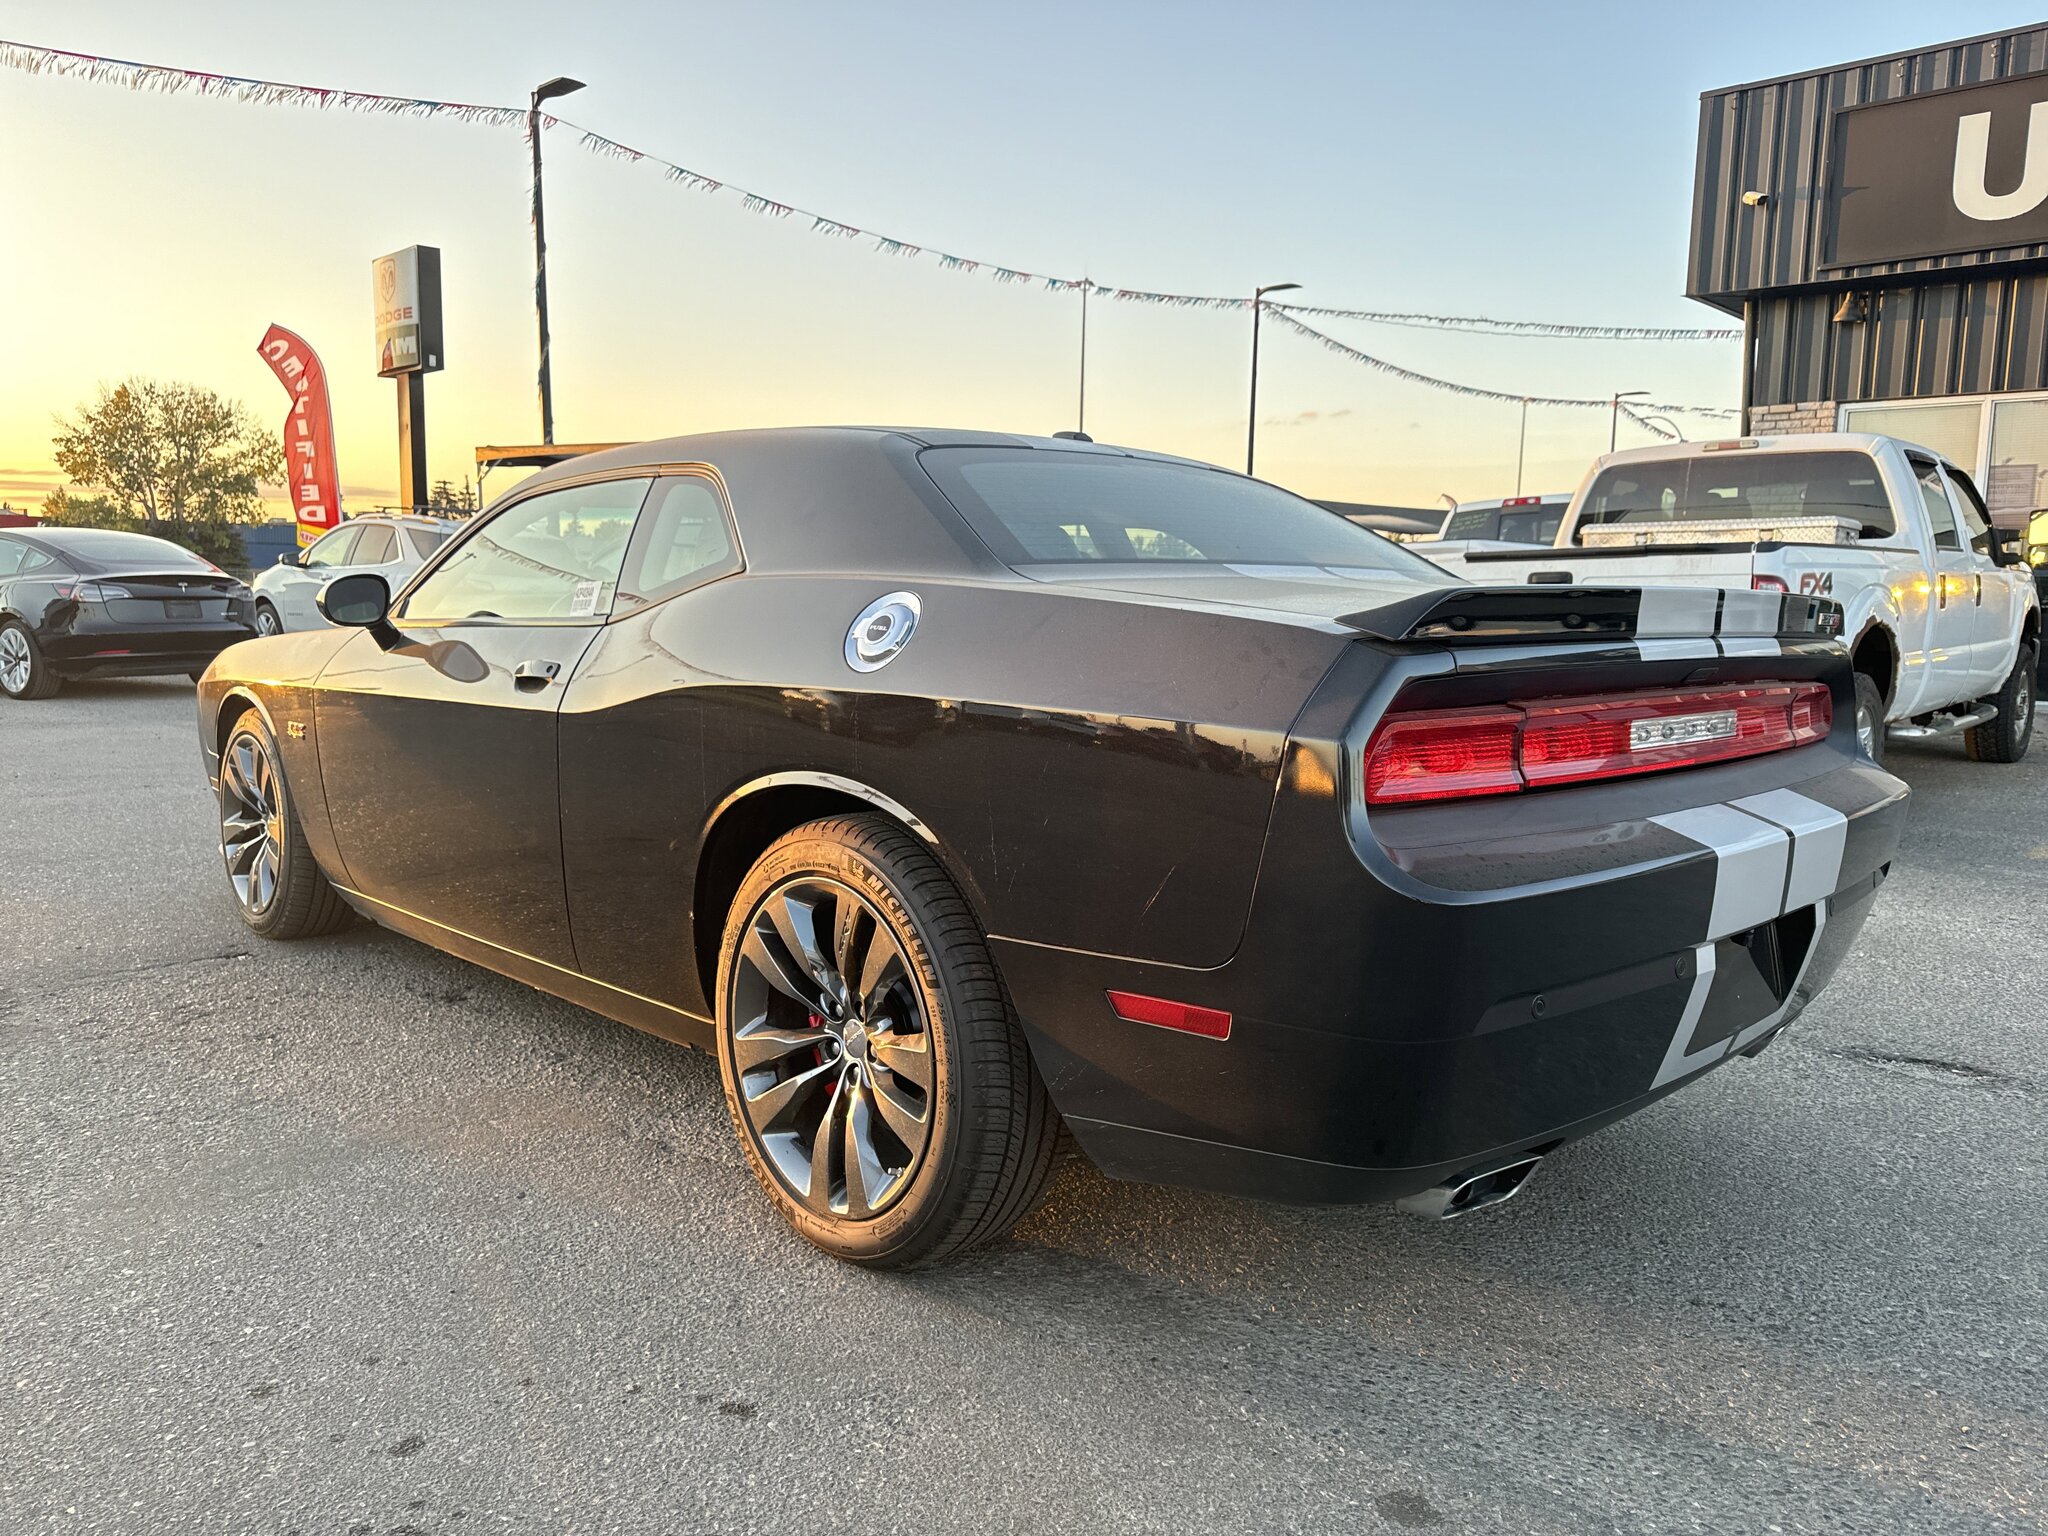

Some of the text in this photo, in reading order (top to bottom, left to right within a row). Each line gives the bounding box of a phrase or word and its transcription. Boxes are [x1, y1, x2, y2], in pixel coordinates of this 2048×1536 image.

[1953, 101, 2048, 221] U
[1800, 572, 1833, 595] FX4
[867, 874, 937, 981] MICHELIN
